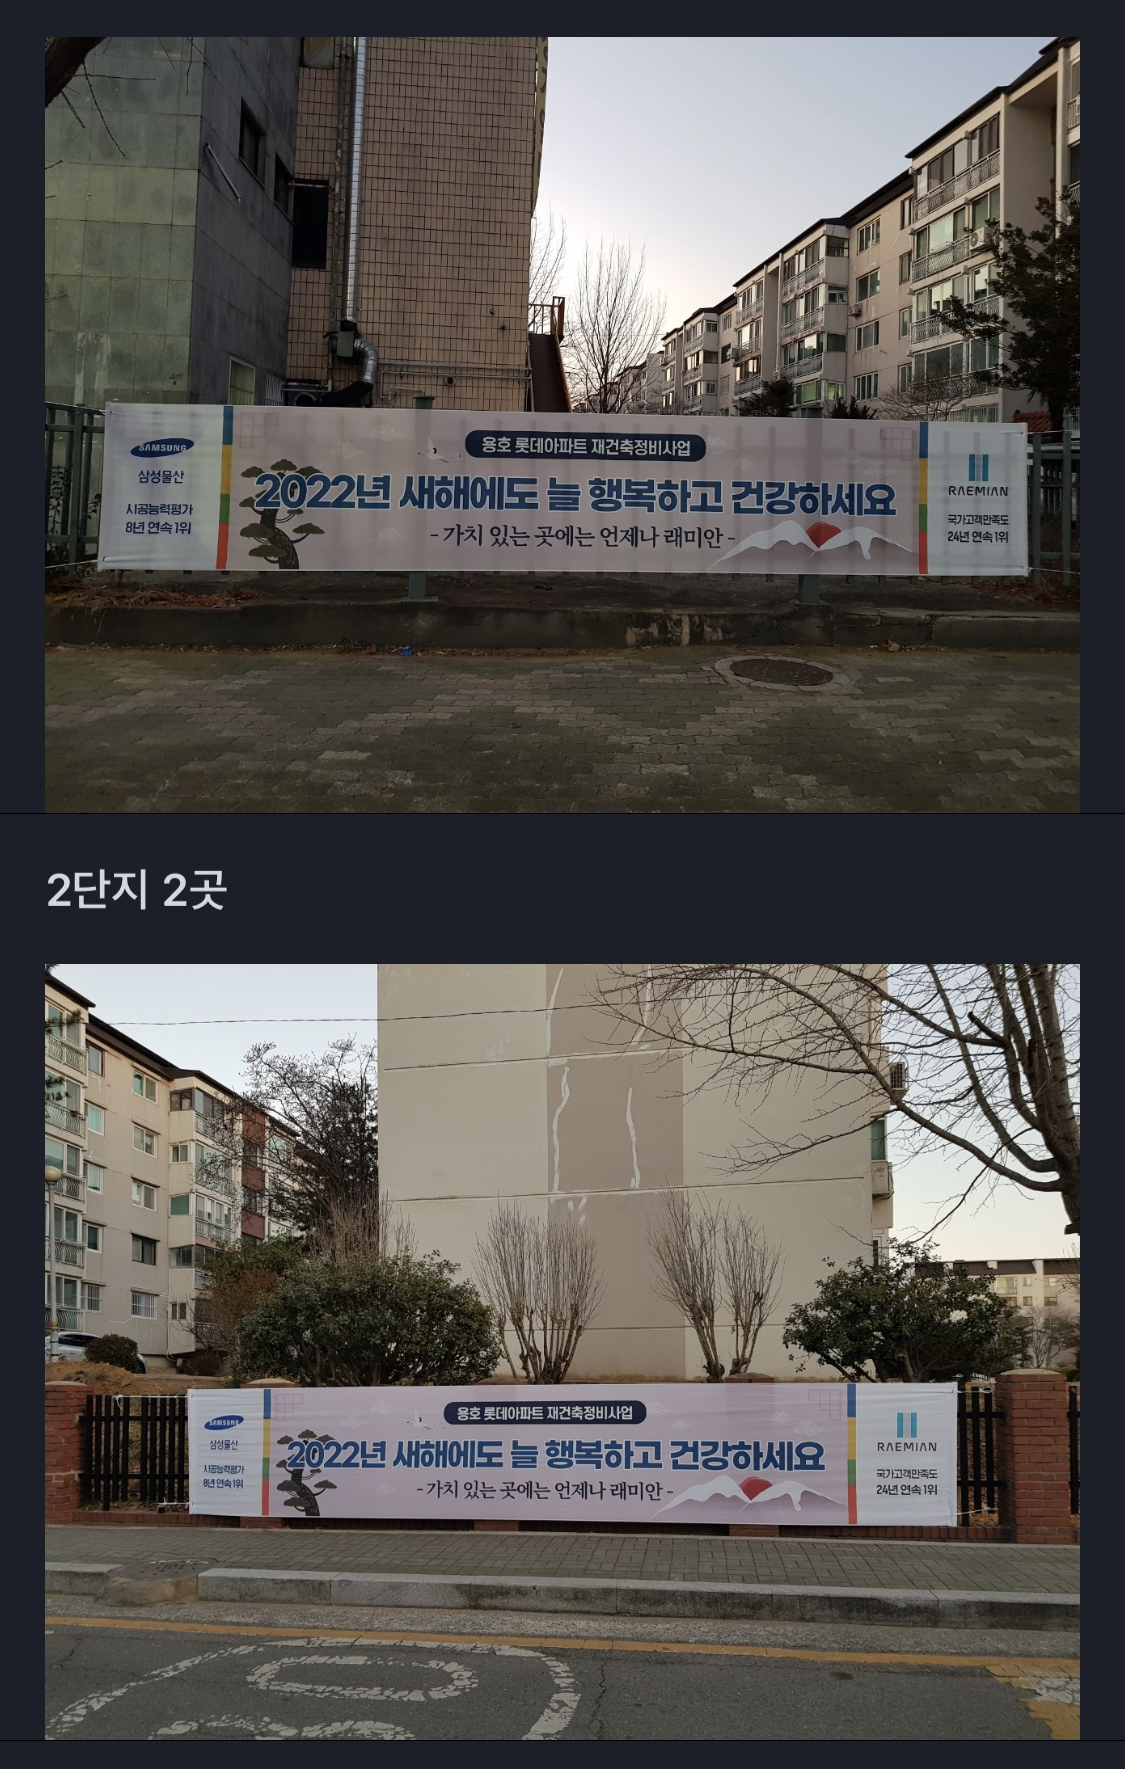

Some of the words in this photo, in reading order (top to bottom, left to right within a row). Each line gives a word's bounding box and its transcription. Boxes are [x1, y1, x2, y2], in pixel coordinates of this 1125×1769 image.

[138, 444, 187, 452] SAMSUNG
[482, 435, 511, 455] 용호
[515, 436, 588, 456] 롯데아파트
[591, 438, 691, 457] 재건축정비사업
[138, 470, 185, 484] 삼성물산
[255, 473, 392, 510] 2022년
[400, 474, 539, 512] 새해에도
[547, 476, 580, 513] 늘
[588, 477, 724, 515] 행복하고
[731, 480, 898, 517] 건강하세요
[948, 485, 1009, 497] RAEMIAN
[126, 503, 194, 515] 시공능력평가
[947, 513, 1009, 526] 국가고객만족도
[125, 521, 145, 534] 8년
[147, 521, 173, 534] 연속
[175, 521, 191, 534] 1위
[442, 524, 484, 547] 가치
[489, 525, 530, 547] 있는
[534, 525, 596, 548] 곳에는
[599, 526, 660, 549] 언제나
[664, 527, 724, 549] 래미안
[947, 530, 970, 543] 24년
[972, 530, 993, 543] 연속
[995, 530, 1009, 543] 1위
[457, 1406, 481, 1421] 용호
[484, 1406, 544, 1421] 롯데아파트
[547, 1405, 632, 1421] 재건축정비사업
[210, 1440, 238, 1450] 삼성물산
[877, 1443, 937, 1452] RAEMIAN
[287, 1440, 386, 1468] 2022년
[393, 1440, 503, 1468] 새해에도
[510, 1440, 539, 1468] 늘
[545, 1440, 662, 1469] 행복하고
[671, 1441, 825, 1471] 건강하세요
[204, 1465, 244, 1474] 시공능력평가
[876, 1469, 937, 1479] 국가고객만족도
[203, 1479, 215, 1489] 8년
[216, 1479, 232, 1489] 연속
[233, 1479, 244, 1489] 1위
[426, 1480, 459, 1499] 가치
[463, 1480, 496, 1500] 있는
[500, 1481, 551, 1500] 곳에는
[555, 1481, 606, 1500] 언제나
[609, 1481, 663, 1501] 래미안
[876, 1485, 898, 1495] 24년
[900, 1484, 921, 1496] 연속
[923, 1484, 937, 1496] 1위
